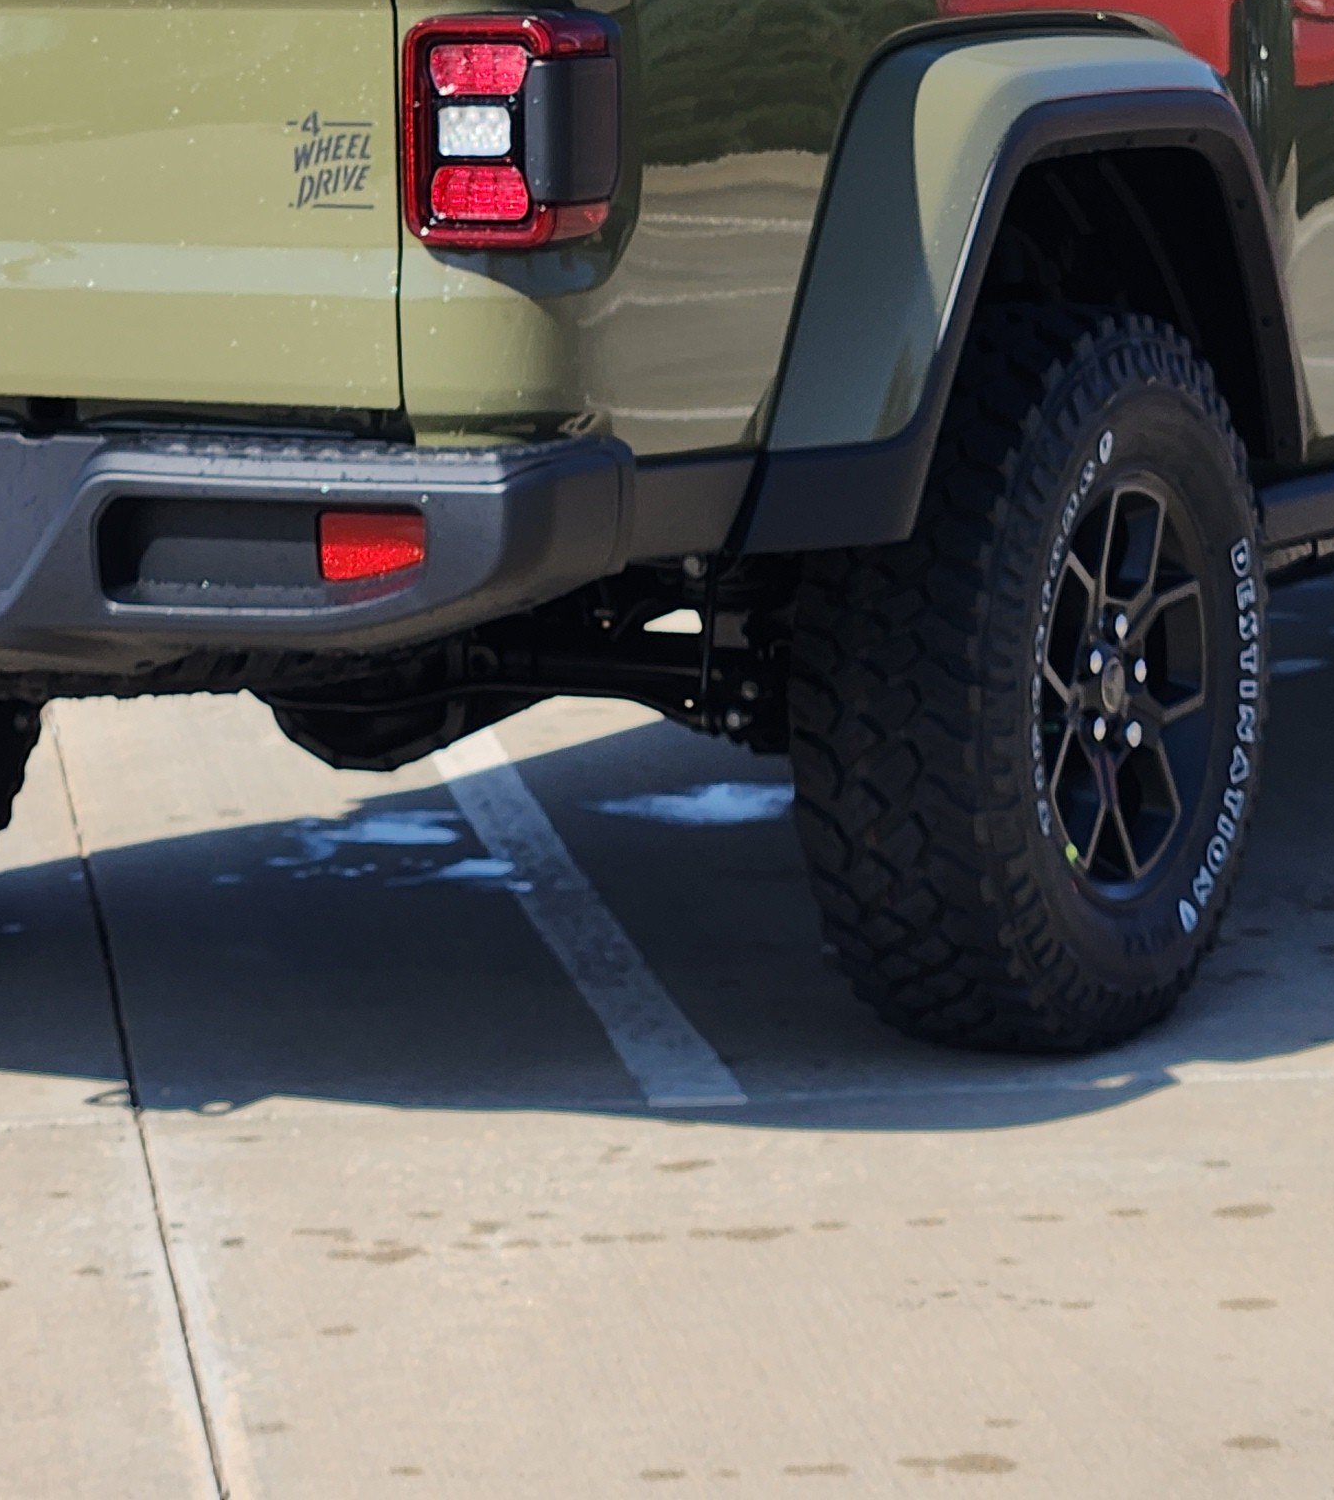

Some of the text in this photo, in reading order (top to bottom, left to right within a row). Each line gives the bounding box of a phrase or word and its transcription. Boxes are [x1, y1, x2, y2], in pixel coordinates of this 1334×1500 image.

[301, 110, 320, 136] 4
[294, 133, 371, 173] WHEEL
[296, 164, 371, 209] DRIVE
[1193, 537, 1259, 907] DESTINATION
